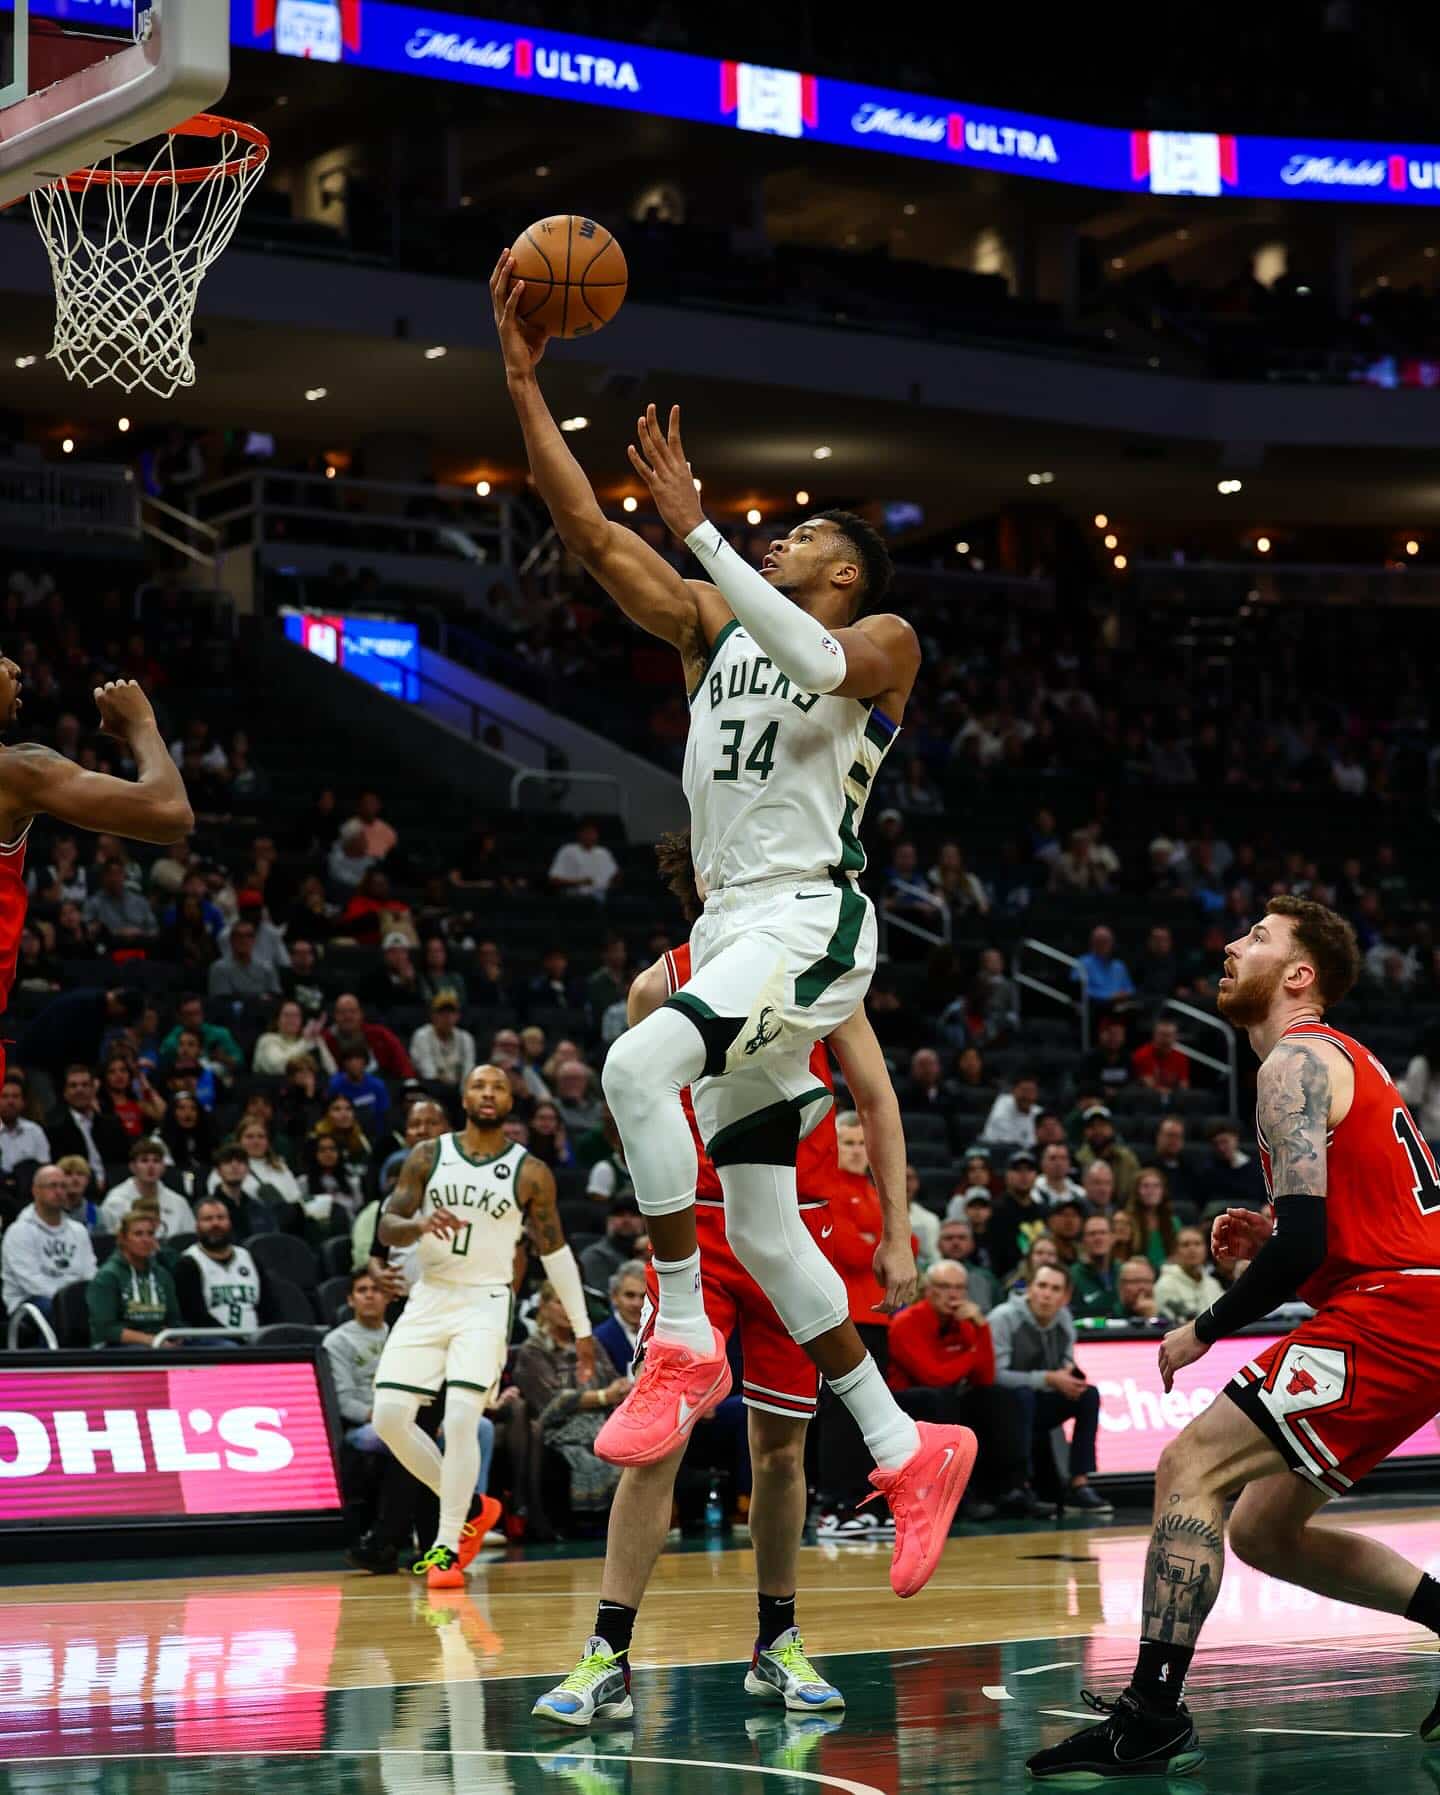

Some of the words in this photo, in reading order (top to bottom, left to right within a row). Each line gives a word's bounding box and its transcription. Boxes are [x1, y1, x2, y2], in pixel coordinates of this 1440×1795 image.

[535, 47, 640, 92] ULTRA
[964, 121, 1058, 163] ULTRA
[712, 719, 780, 781] 34
[1392, 1107, 1440, 1216] 1
[429, 1184, 511, 1219] BUCKS
